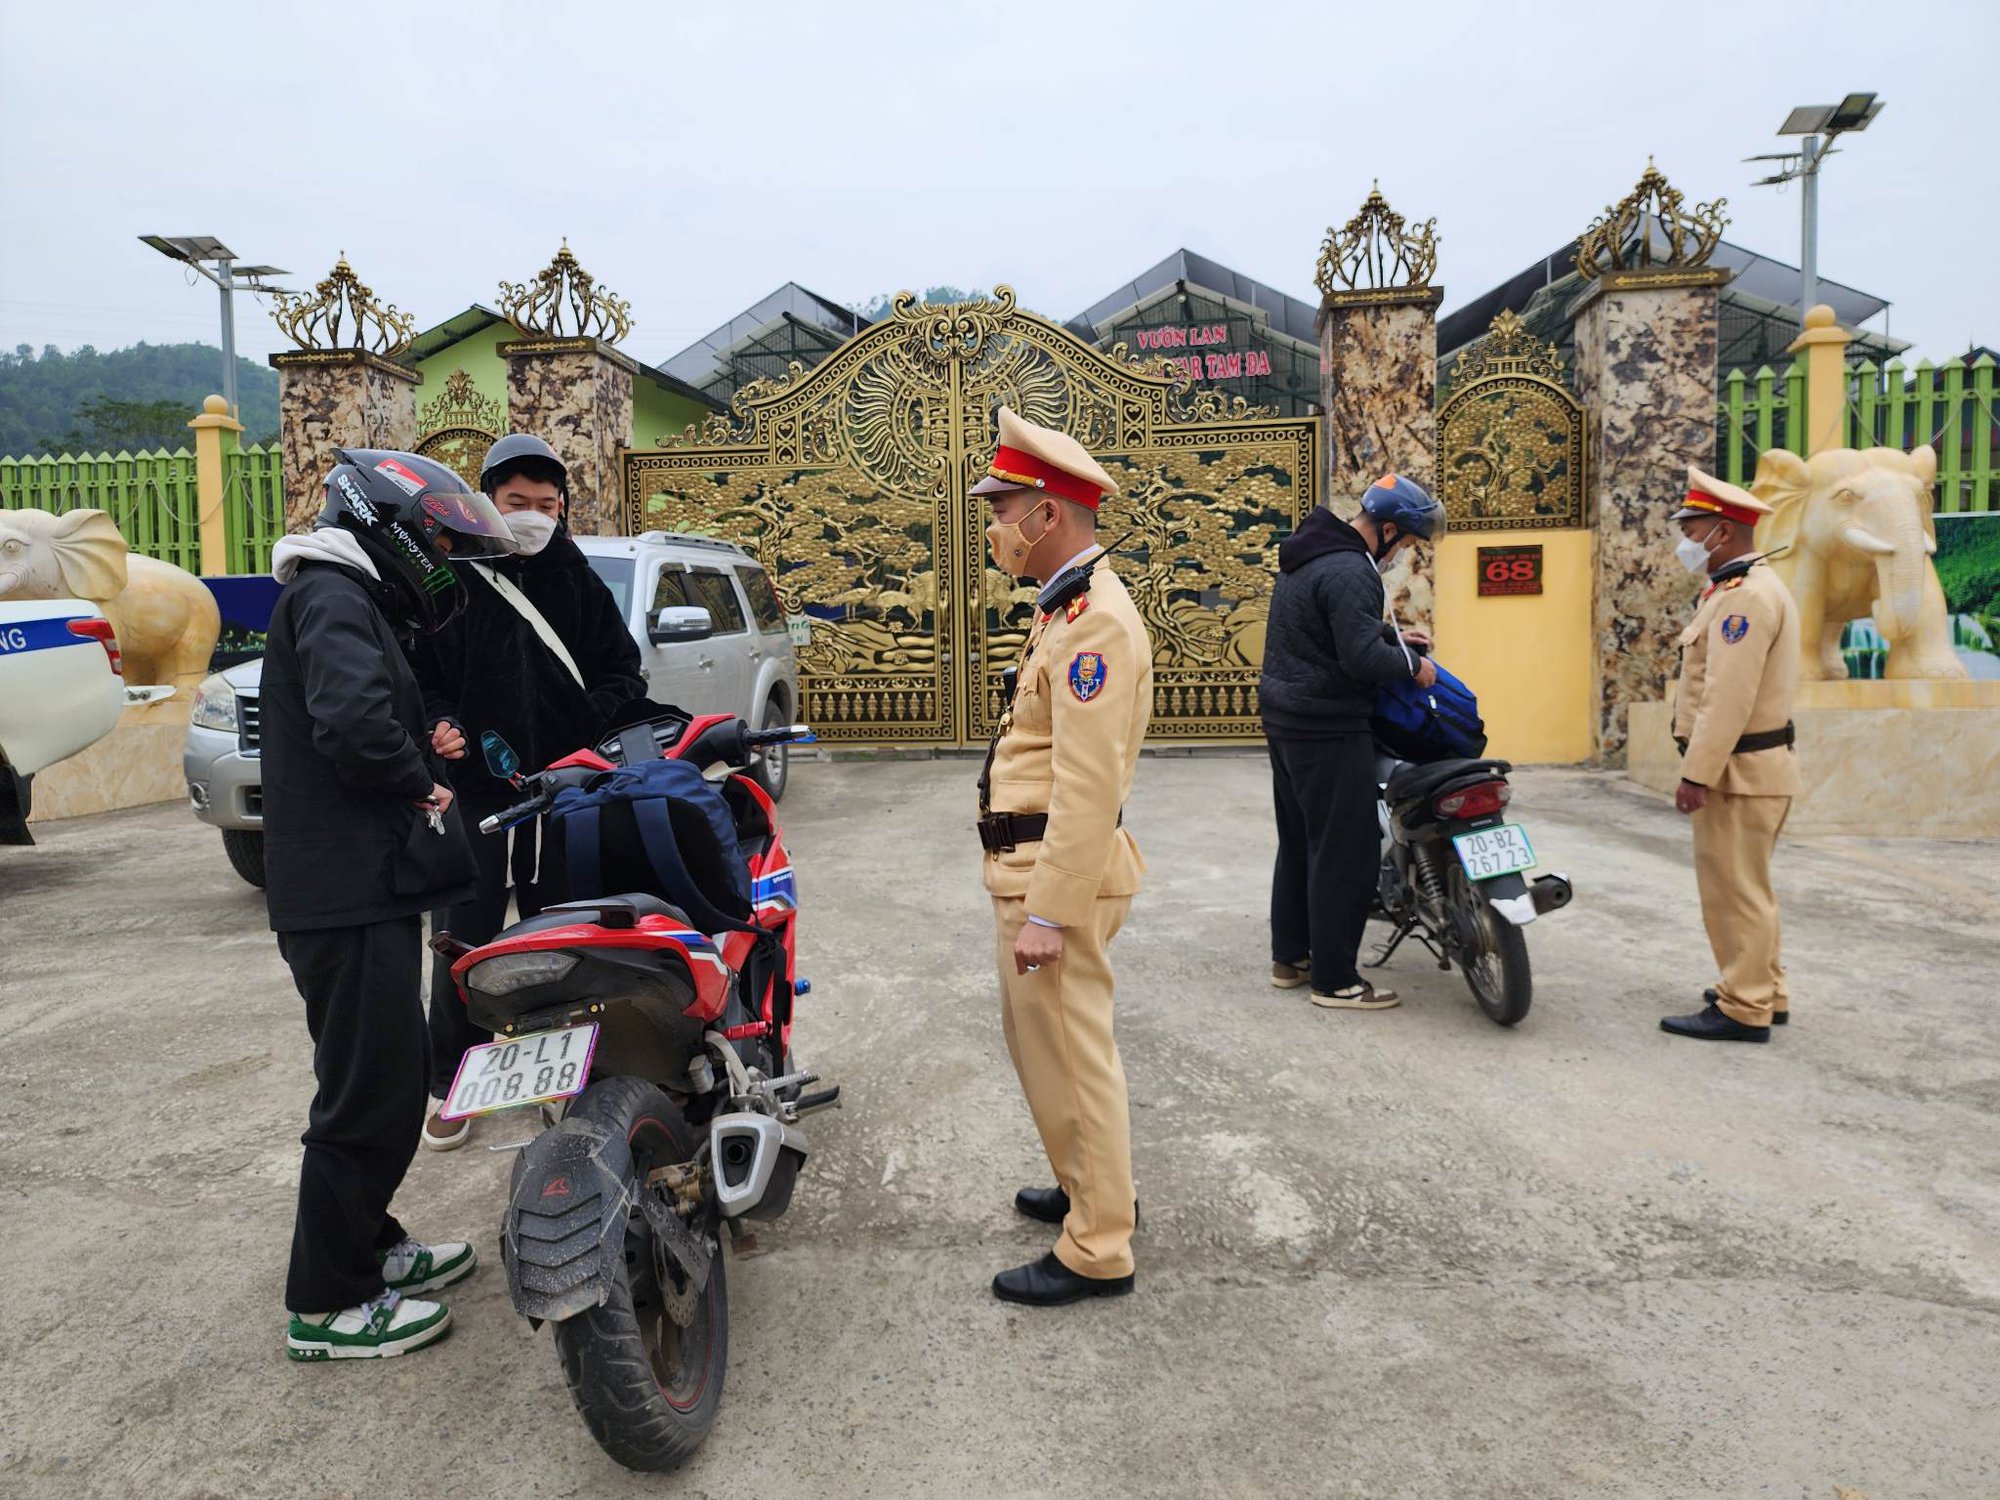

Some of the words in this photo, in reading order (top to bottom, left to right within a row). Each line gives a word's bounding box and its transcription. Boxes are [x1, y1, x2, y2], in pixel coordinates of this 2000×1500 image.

[1189, 325, 1228, 346] LAN
[1205, 352, 1241, 380] TAM
[338, 474, 379, 527] SHARK
[1486, 560, 1535, 582] 68
[1466, 829, 1517, 855] 20-B2
[480, 1031, 573, 1076] 20-L1
[456, 1061, 577, 1111] 008.88
